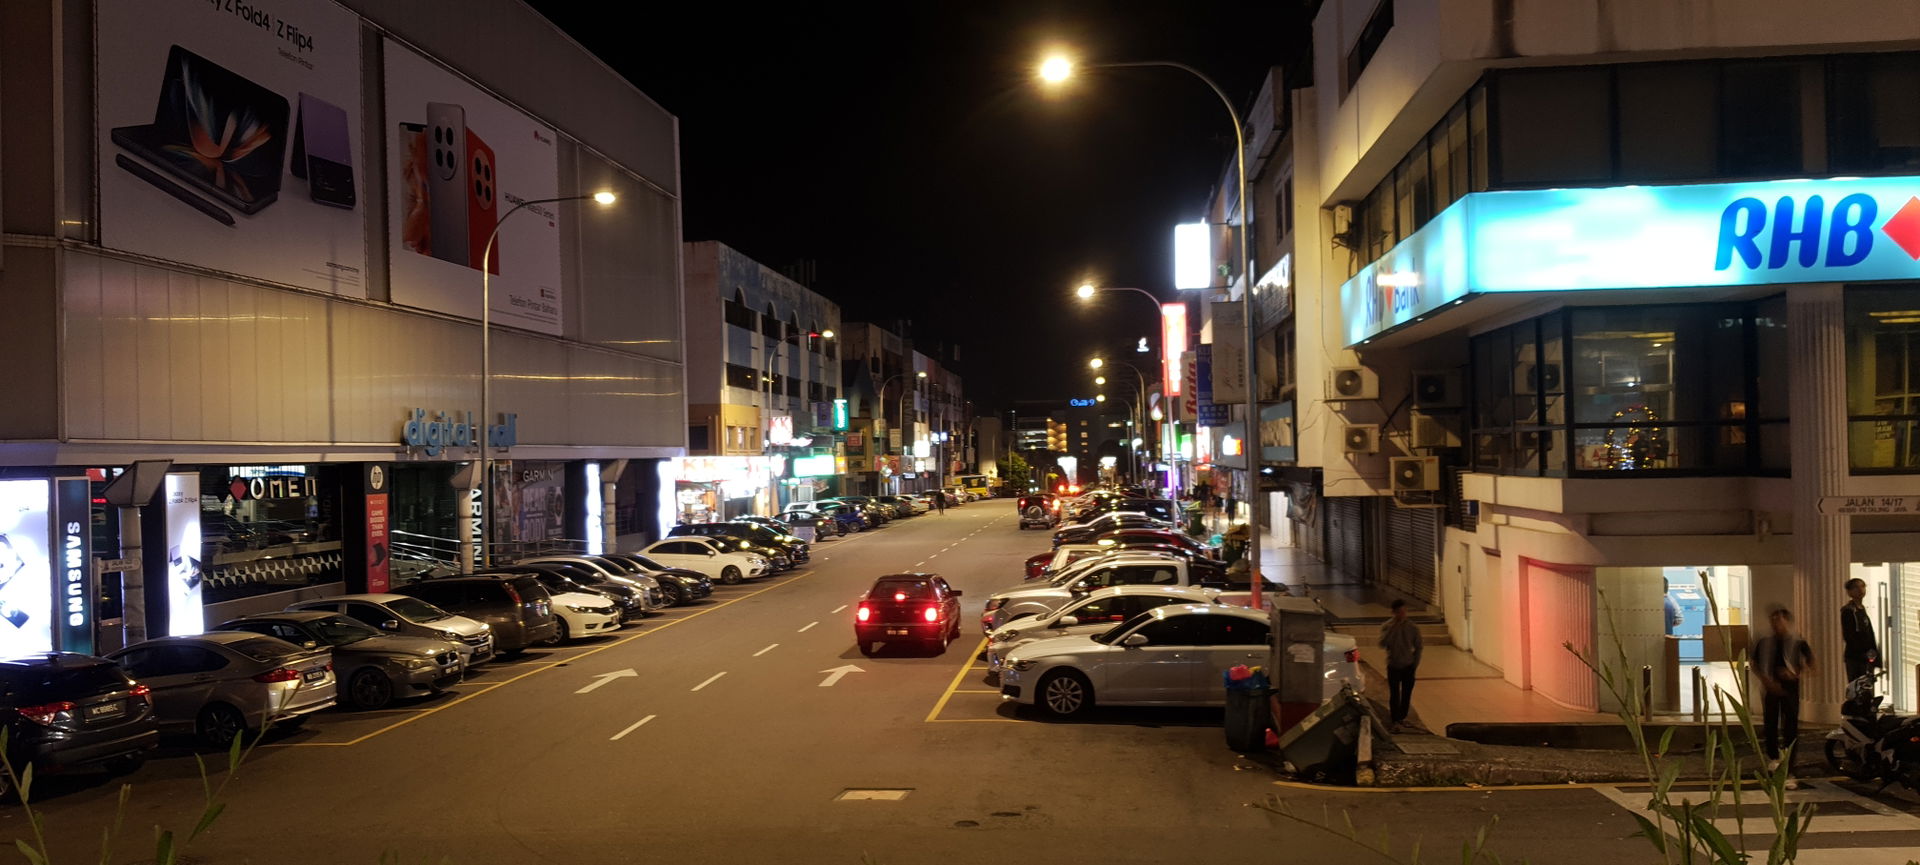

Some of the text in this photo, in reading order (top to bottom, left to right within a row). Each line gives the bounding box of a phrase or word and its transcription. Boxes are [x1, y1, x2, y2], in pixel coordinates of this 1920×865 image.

[235, 0, 271, 31] Fold4
[277, 19, 284, 39] Z
[286, 24, 314, 53] Flip4
[1714, 192, 1878, 271] RHB
[1184, 361, 1197, 415] Bata
[404, 407, 472, 457] digital
[250, 475, 317, 500] OMEN
[522, 469, 554, 482] GARMIN
[470, 486, 482, 560] ARMIN
[1844, 498, 1903, 507] JALAN 14/17
[66, 521, 84, 627] SAMSUNG
